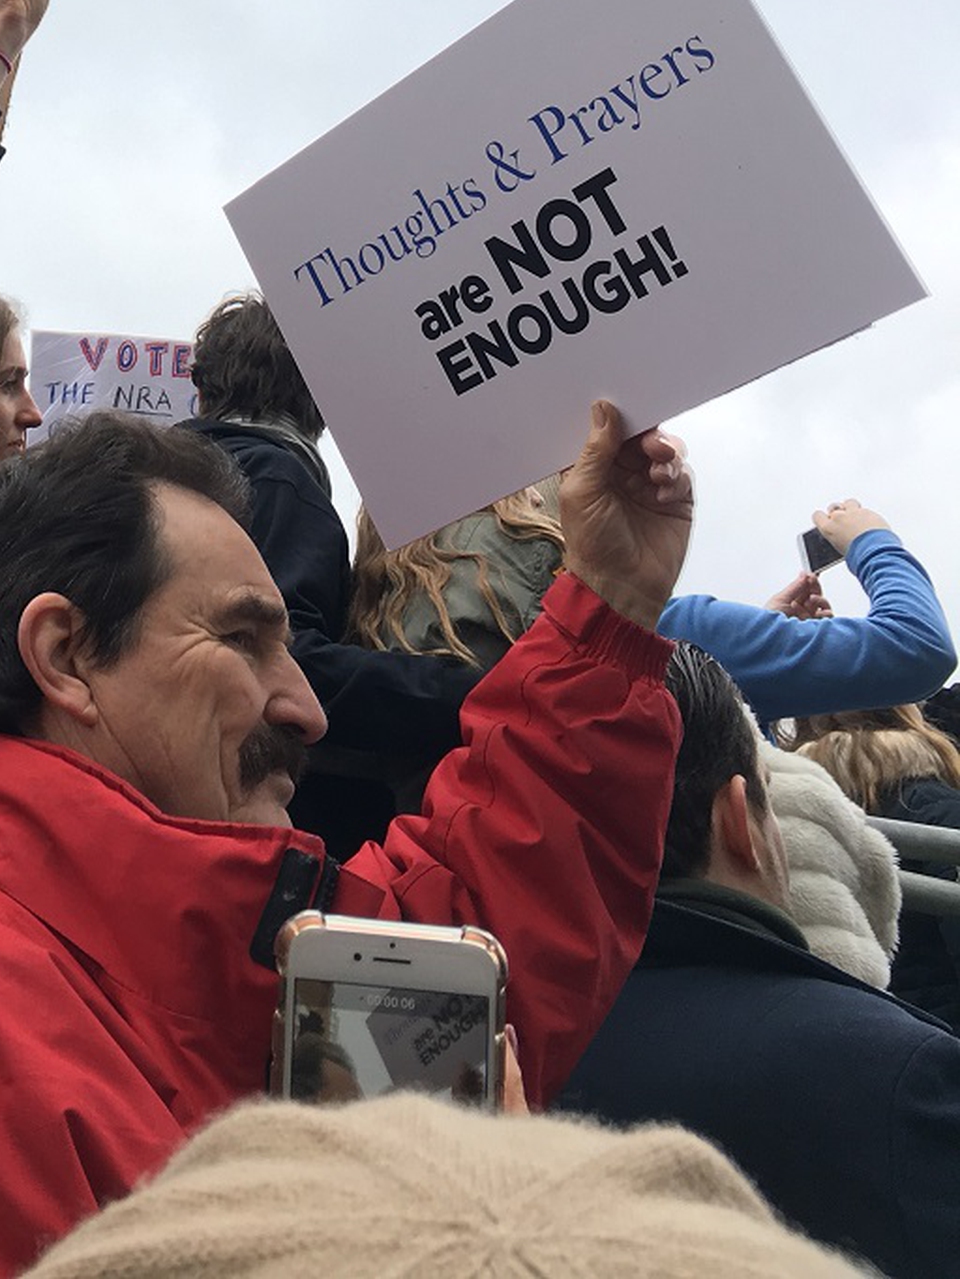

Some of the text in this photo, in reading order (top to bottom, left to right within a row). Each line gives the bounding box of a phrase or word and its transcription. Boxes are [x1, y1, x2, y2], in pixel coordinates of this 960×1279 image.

[293, 34, 717, 309] Thoughts & Prayers
[414, 167, 628, 340] are NOT
[46, 380, 95, 405] THE
[113, 384, 172, 411] NRA
[436, 224, 689, 396] ENOUGH!
